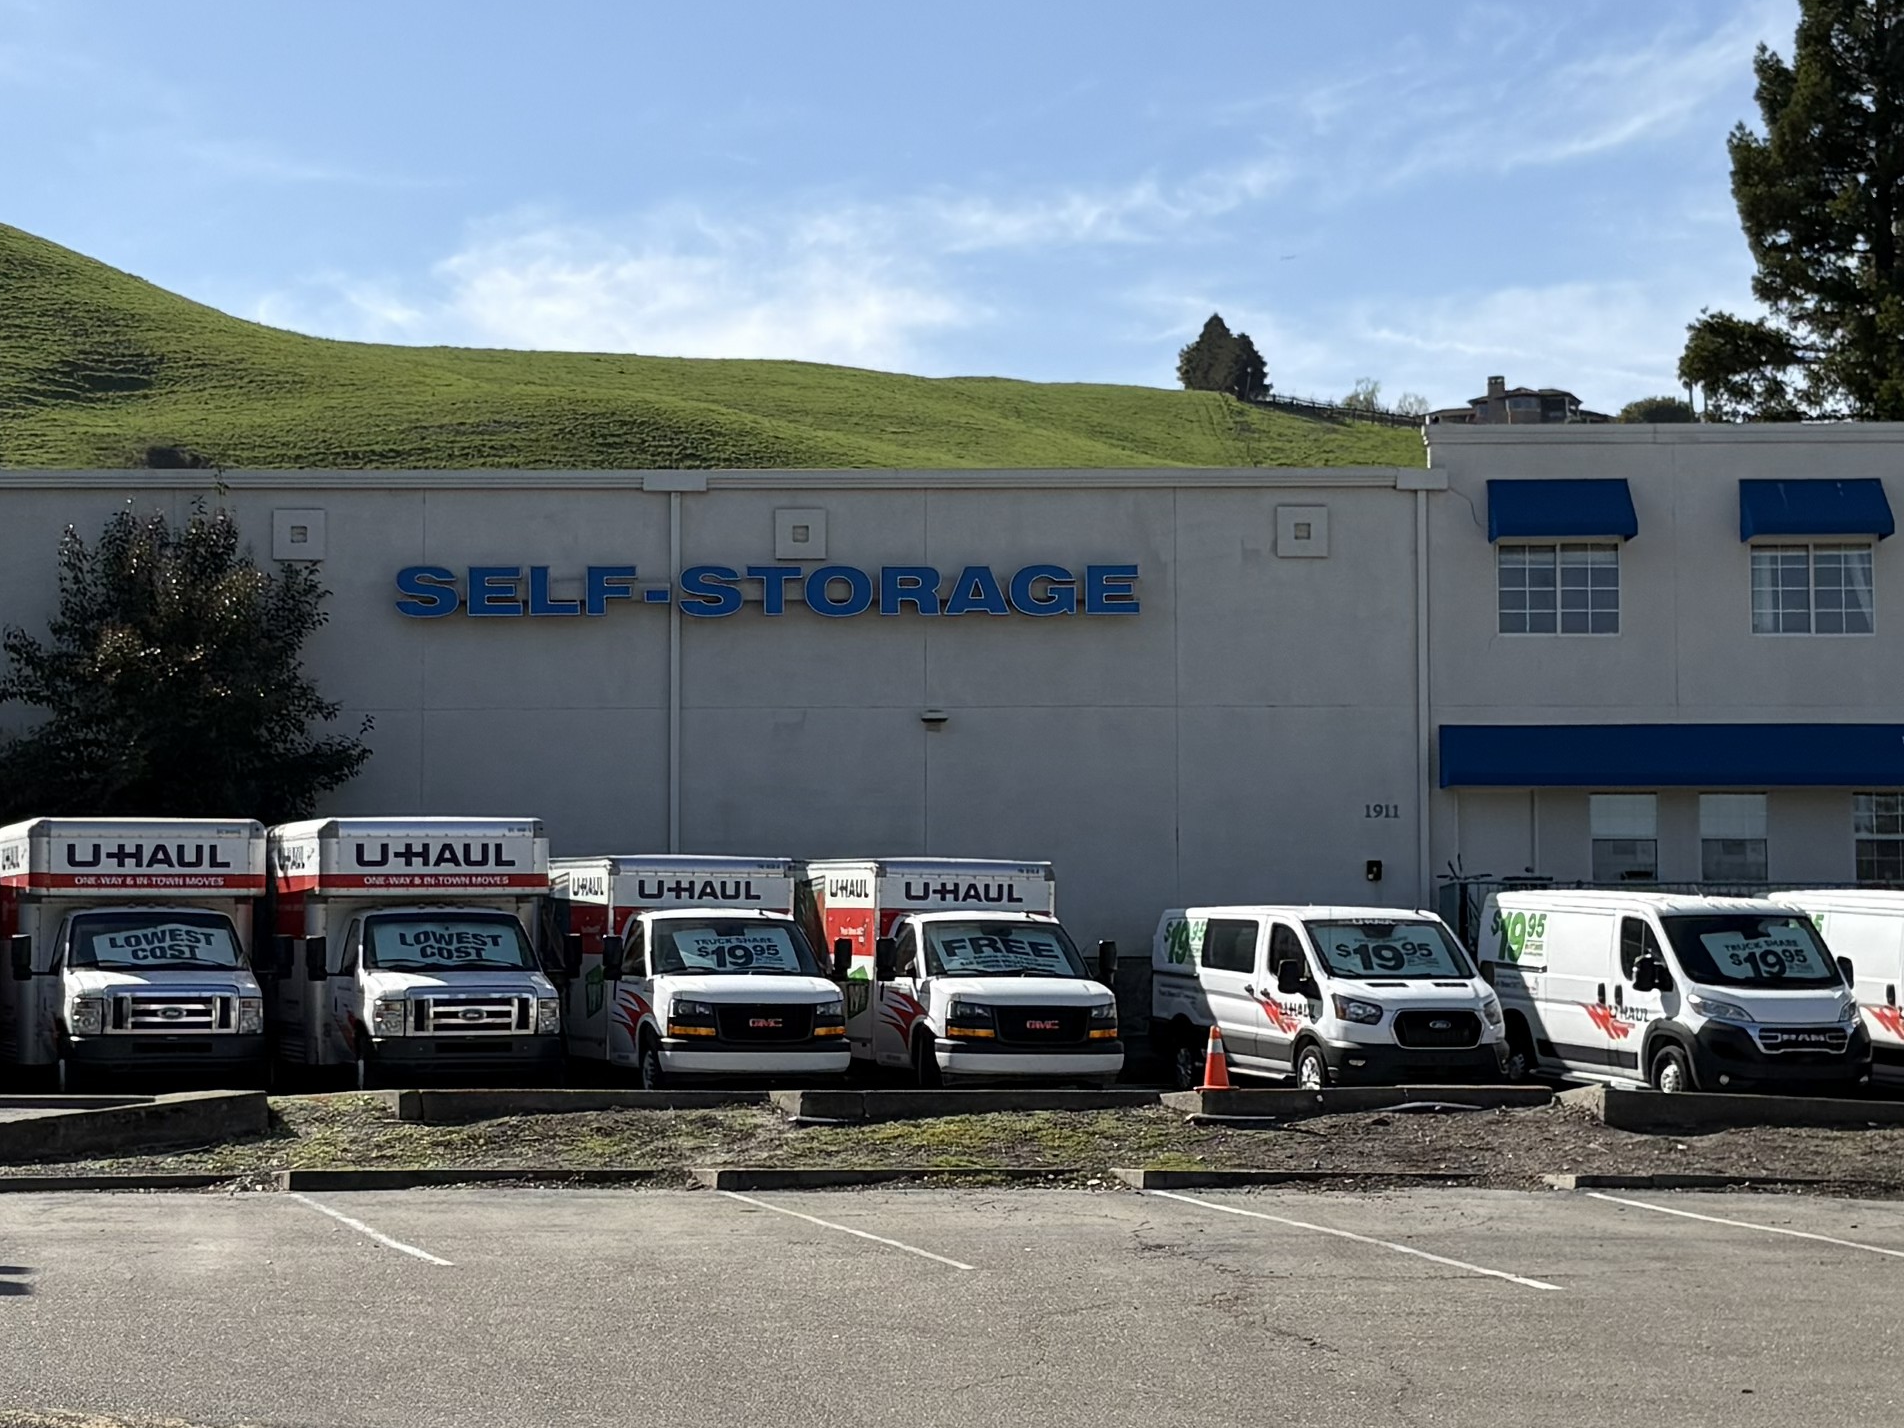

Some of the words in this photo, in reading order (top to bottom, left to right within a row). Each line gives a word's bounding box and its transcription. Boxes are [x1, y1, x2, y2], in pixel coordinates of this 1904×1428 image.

[395, 564, 1140, 618] SELF-STORAGE
[1364, 803, 1401, 819] 1911
[66, 843, 231, 869] U-HAUL
[355, 843, 517, 868] U-HAUL
[74, 876, 125, 886] ONE-WAY
[125, 876, 134, 886] &
[136, 876, 184, 886] IN-TOWN
[185, 876, 225, 887] MOVES
[363, 875, 412, 886] ONE-WAY
[414, 875, 422, 886] &
[423, 875, 470, 886] IN-TOWN
[471, 875, 510, 885] MOVES
[572, 876, 604, 896] U-HAUL
[829, 878, 869, 899] U-HAUL
[637, 879, 762, 901] U-HAUL
[904, 881, 1024, 903] U-HAUL
[108, 928, 216, 949] LOWEST
[398, 930, 504, 947] LOWEST
[694, 938, 734, 946] TRUCK
[734, 936, 775, 945] SHARE
[1724, 941, 1763, 952] TRUCK
[131, 943, 201, 961] COST
[419, 944, 487, 960] COST
[940, 936, 1061, 960] FREE
[748, 1018, 784, 1027] GMC
[1025, 1020, 1060, 1030] GMC
[1781, 1033, 1827, 1042] RAM
